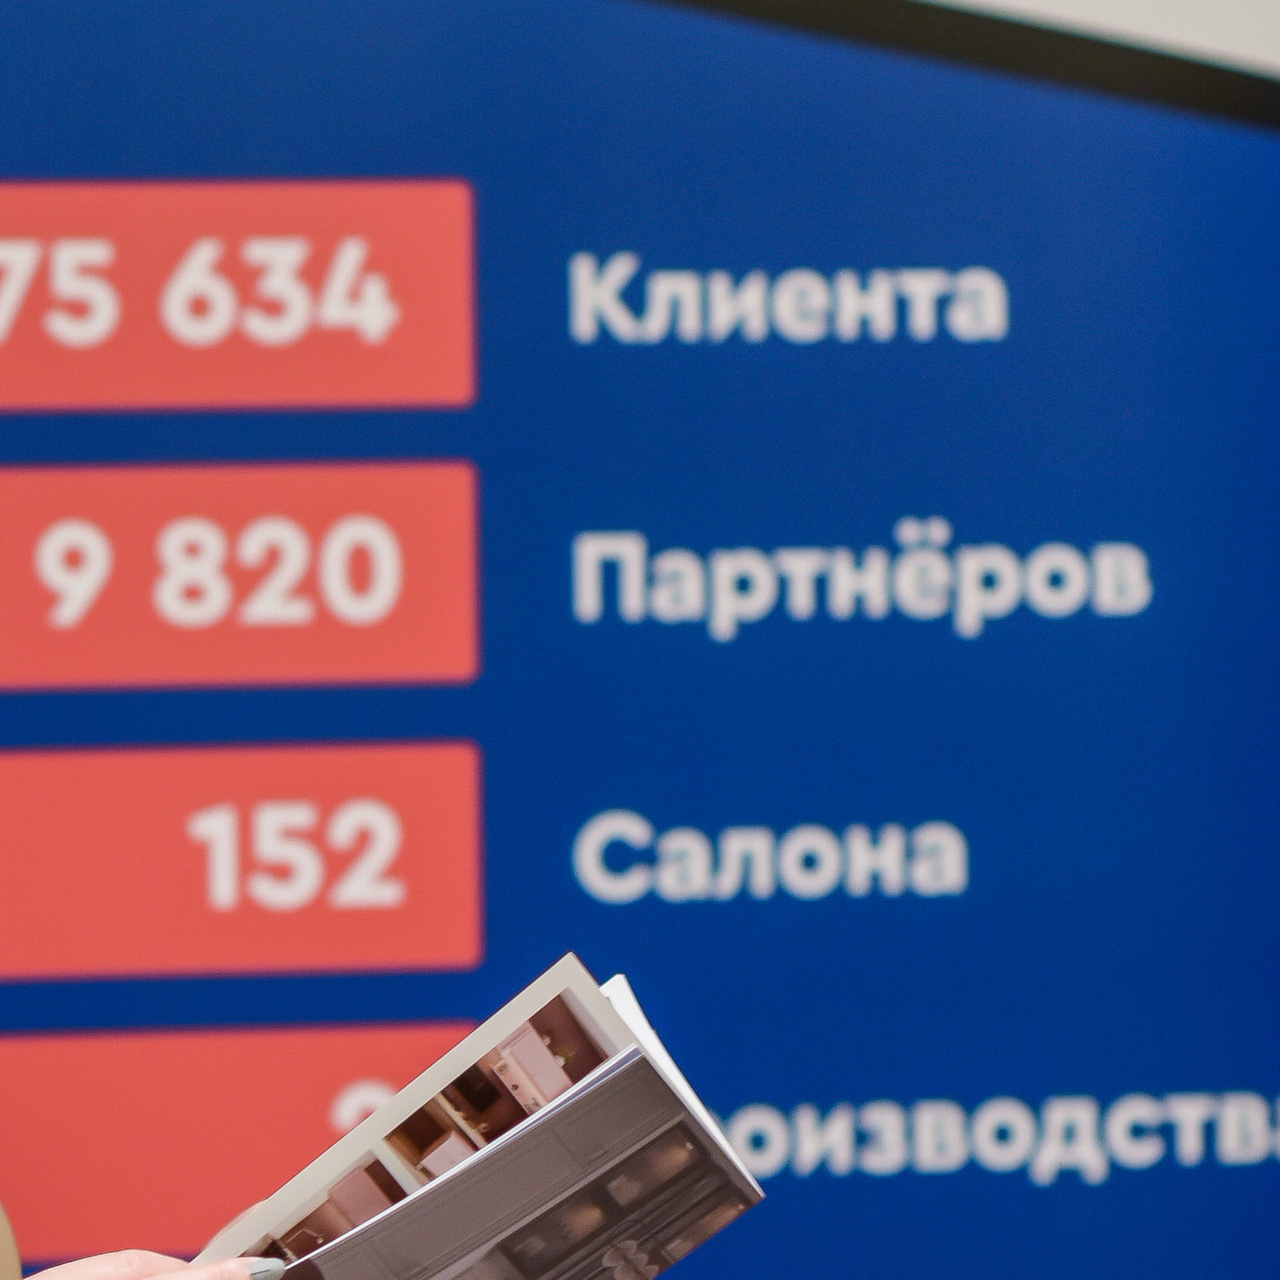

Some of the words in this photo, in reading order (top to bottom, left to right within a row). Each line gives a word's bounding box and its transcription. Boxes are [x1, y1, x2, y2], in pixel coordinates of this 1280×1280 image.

[160, 237, 400, 346] 634
[568, 252, 1010, 344] Клиента
[35, 519, 113, 628] 9
[153, 515, 403, 628] 820
[573, 517, 1154, 642] Партнёров
[187, 799, 406, 911] 152
[572, 810, 969, 904] Салона
[710, 1091, 1280, 1185] оизводств
